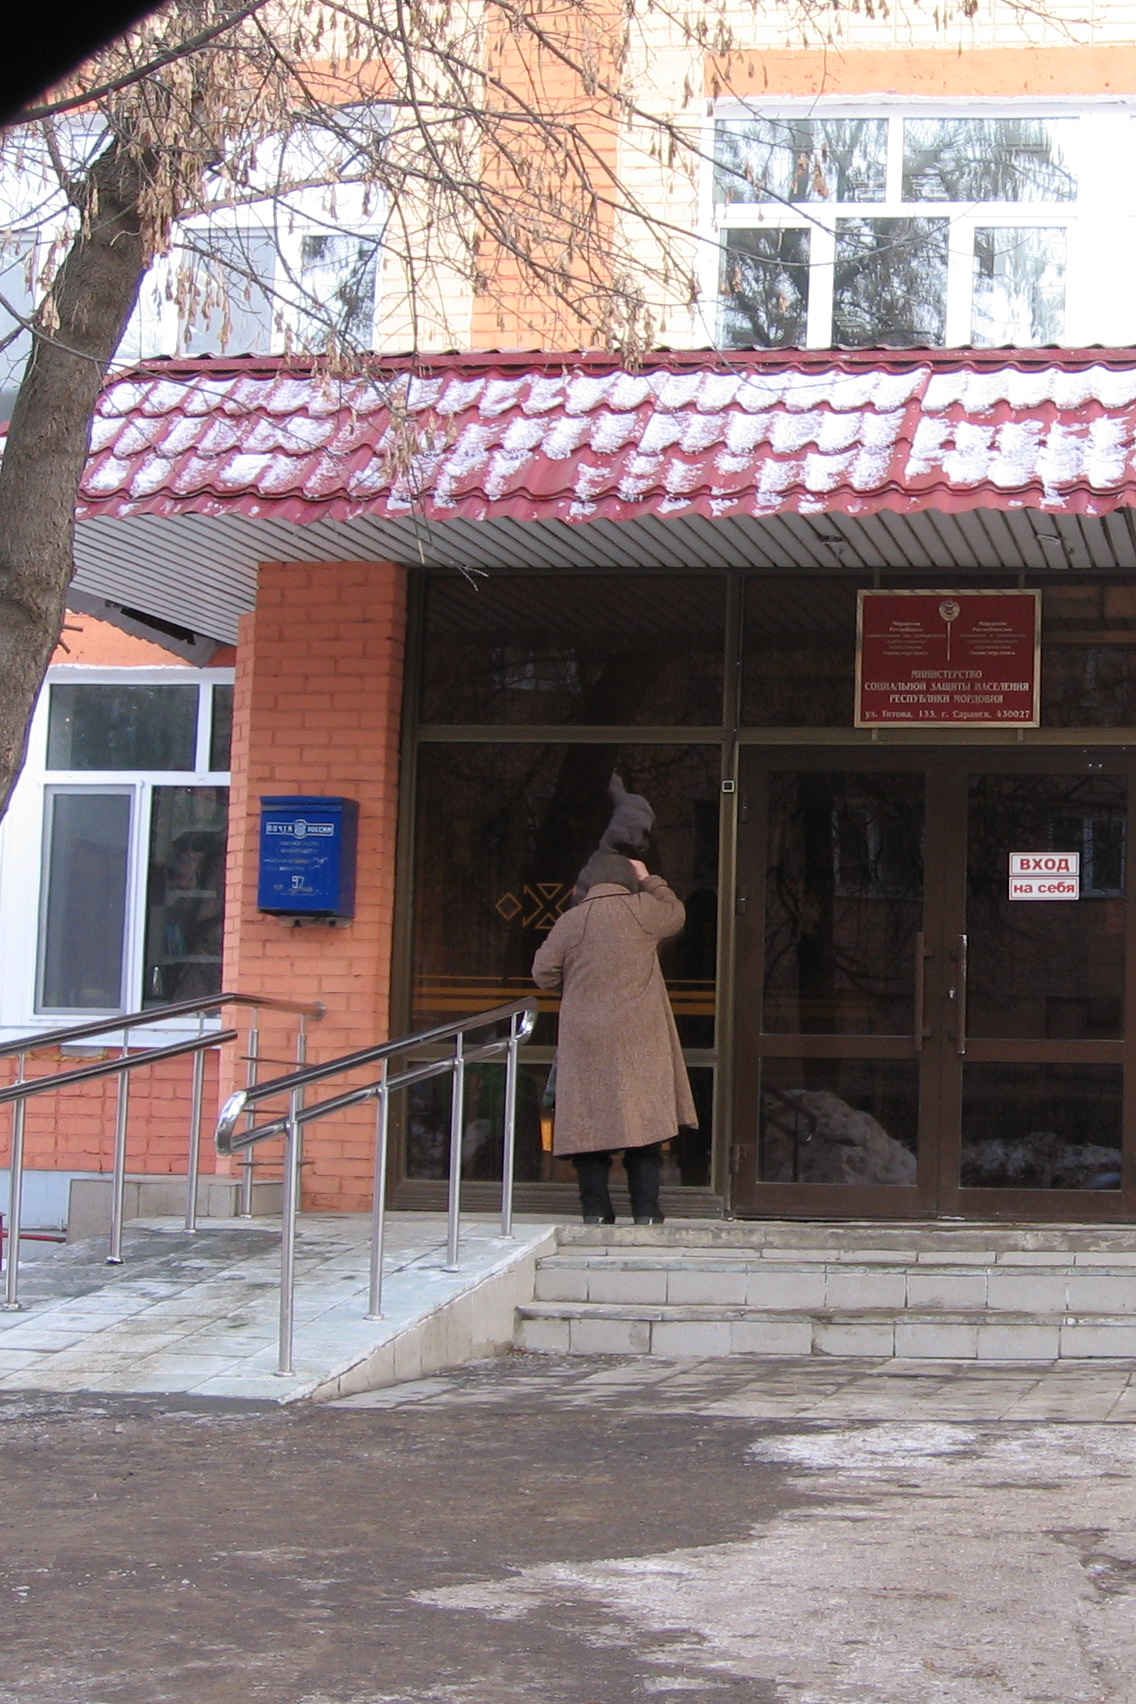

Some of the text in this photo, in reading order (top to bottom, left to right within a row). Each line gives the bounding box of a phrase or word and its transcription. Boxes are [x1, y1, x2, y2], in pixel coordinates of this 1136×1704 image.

[911, 669, 983, 679] МИНИСТЕРСТВО
[864, 681, 1029, 692] СОЦИАЛЬНОЙ ЗАЩИТЫ НАСЕЛЕНИЯ
[889, 694, 1004, 704] РЕСПУБЛИКИ МОРДОВИЯ
[996, 710, 1031, 719] 430027
[1019, 858, 1070, 873] ВХОД
[1013, 881, 1075, 893] на себя
